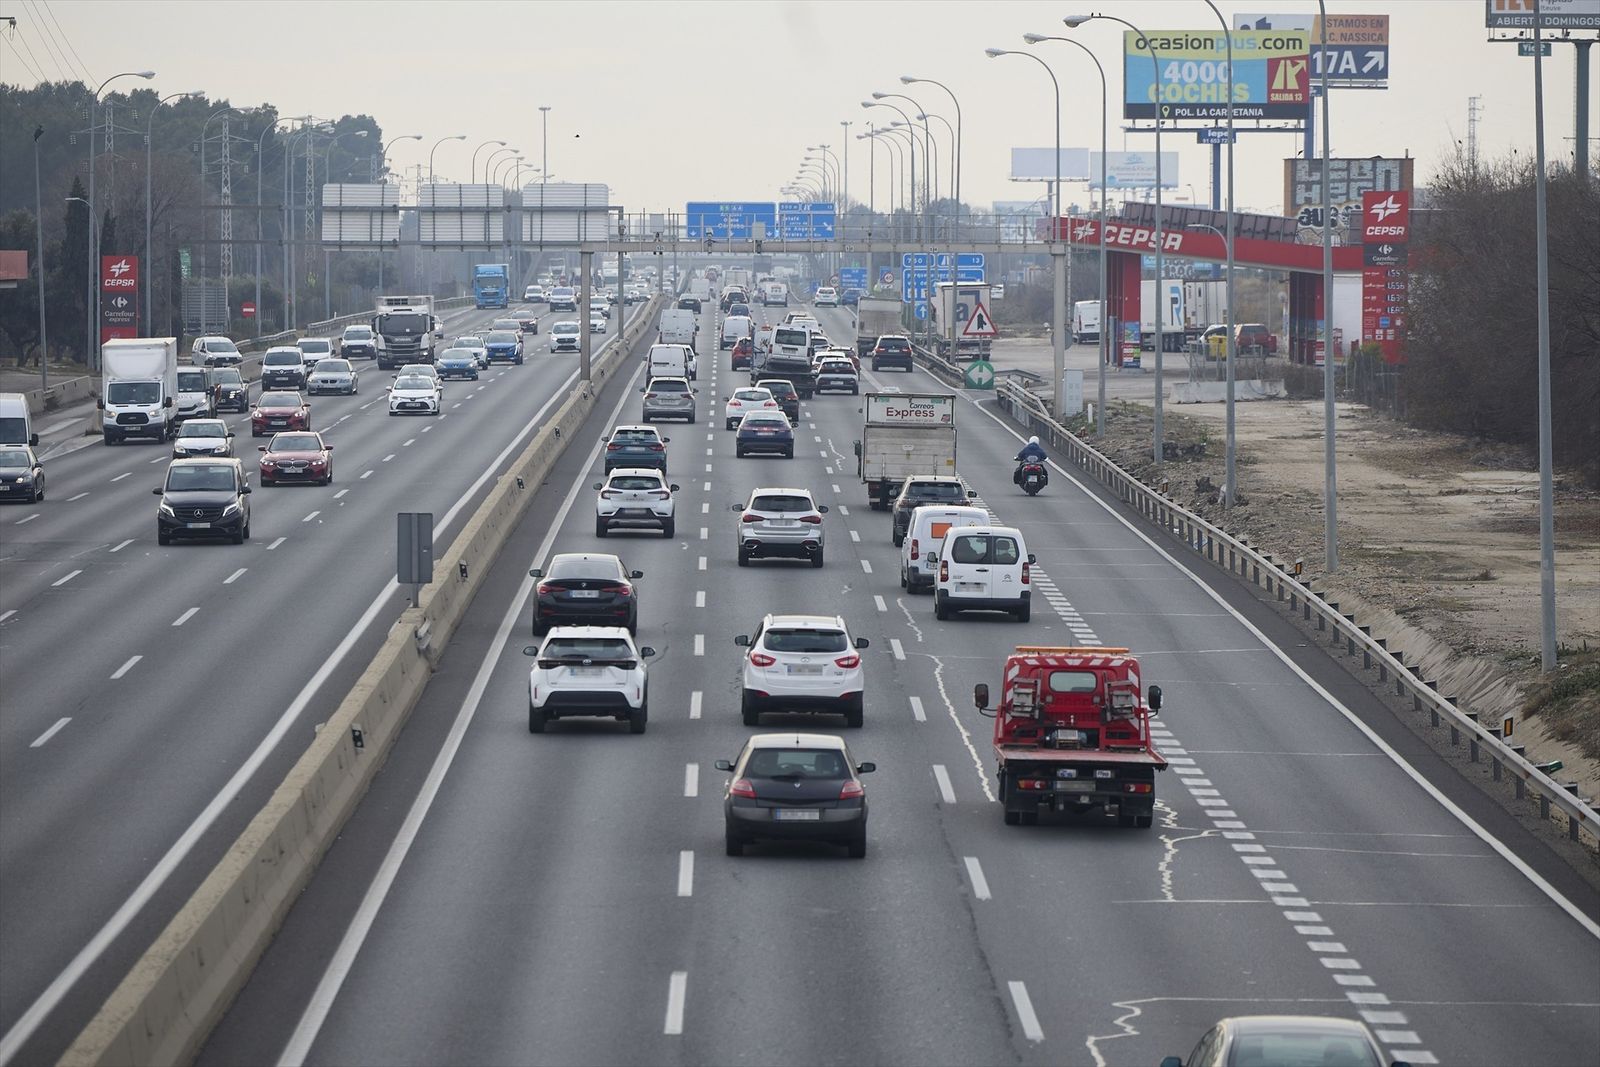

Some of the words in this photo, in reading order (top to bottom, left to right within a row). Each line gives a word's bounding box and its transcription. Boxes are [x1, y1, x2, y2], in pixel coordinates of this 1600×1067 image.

[1326, 19, 1368, 28] STAMOS
[1370, 19, 1384, 28] EN
[1496, 17, 1542, 25] ABIERT
[1545, 17, 1600, 25] DOMINGOS
[1340, 32, 1384, 42] NASSICA
[1312, 51, 1358, 74] 17A
[1164, 61, 1234, 83] 4000
[1148, 83, 1250, 103] COCHES
[1270, 93, 1293, 101] SALIDA
[1294, 93, 1303, 101] 13
[1175, 108, 1195, 116] POL.
[1196, 108, 1208, 116] LA
[1209, 108, 1264, 116] CARETANIA
[1366, 226, 1405, 236] CEPSA
[1104, 225, 1184, 251] CEPSA
[104, 279, 135, 287] CEPSA
[909, 402, 935, 410] Correos
[886, 407, 936, 419] Express
